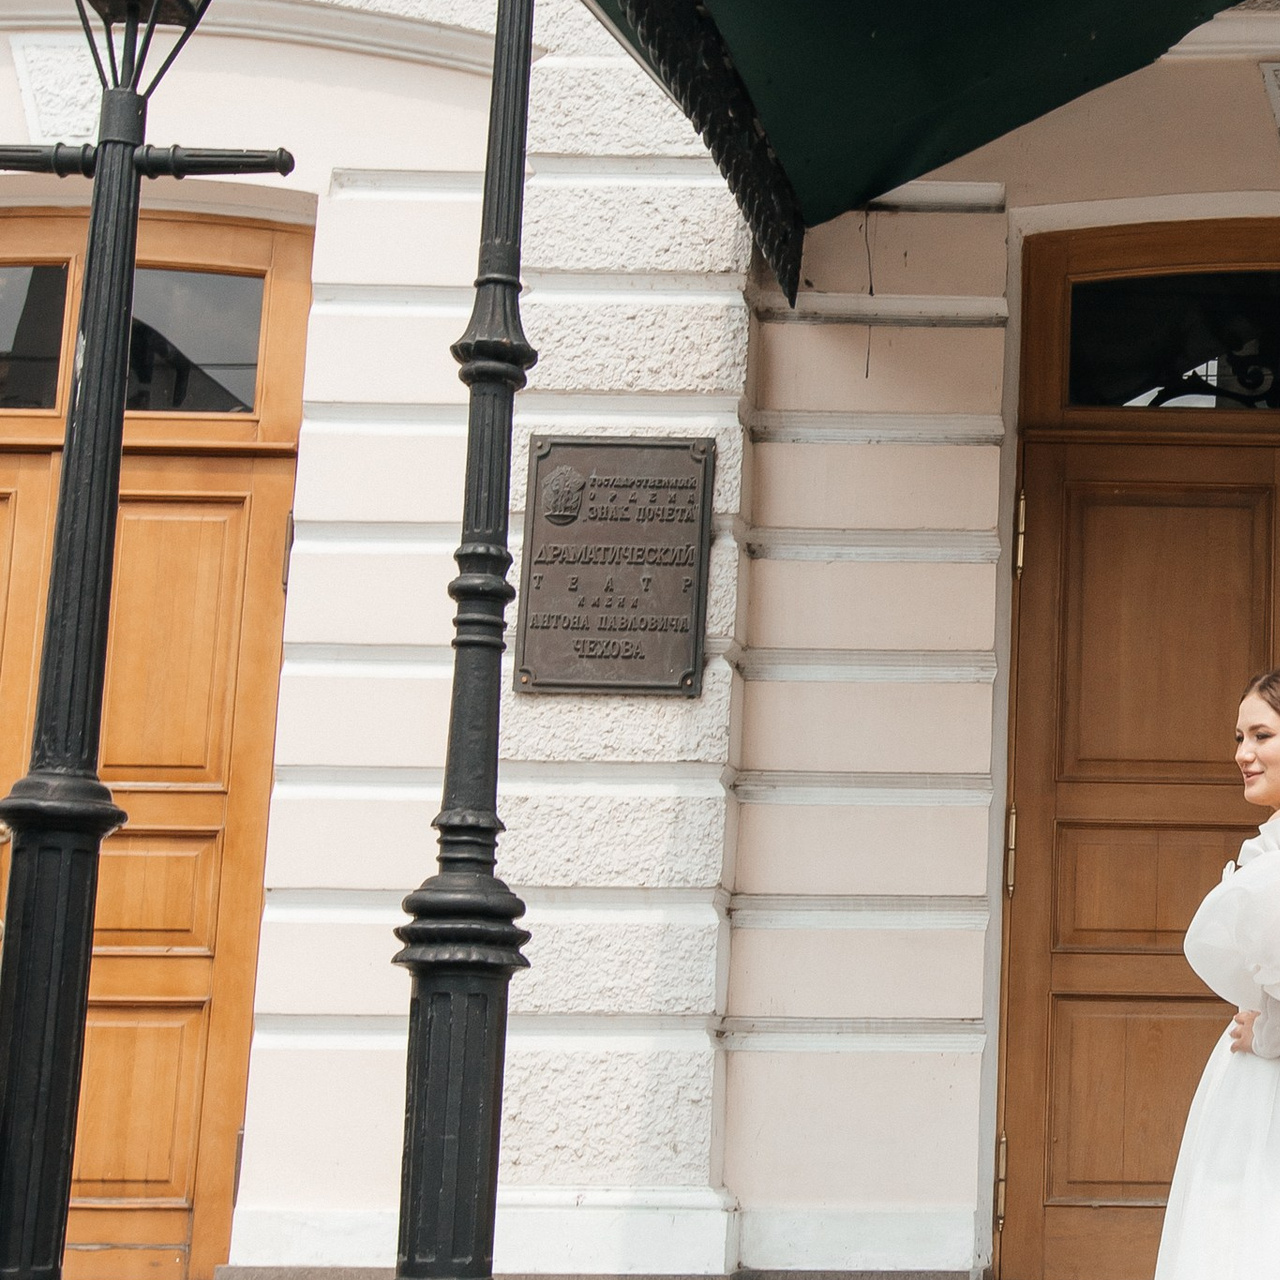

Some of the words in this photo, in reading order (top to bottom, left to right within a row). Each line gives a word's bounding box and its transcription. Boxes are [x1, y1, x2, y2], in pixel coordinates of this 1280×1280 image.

[589, 491, 695, 504] ОРДЕНА
[534, 543, 695, 566] ДРАМАТИЧЕСКИЙ
[533, 573, 693, 593] ТЕАТР
[577, 595, 640, 608] ИМЕНИ
[530, 612, 590, 630] АНТОНА
[597, 614, 690, 633] ПАВЛОВИЧА
[573, 638, 646, 660] ЧЕХОВА
